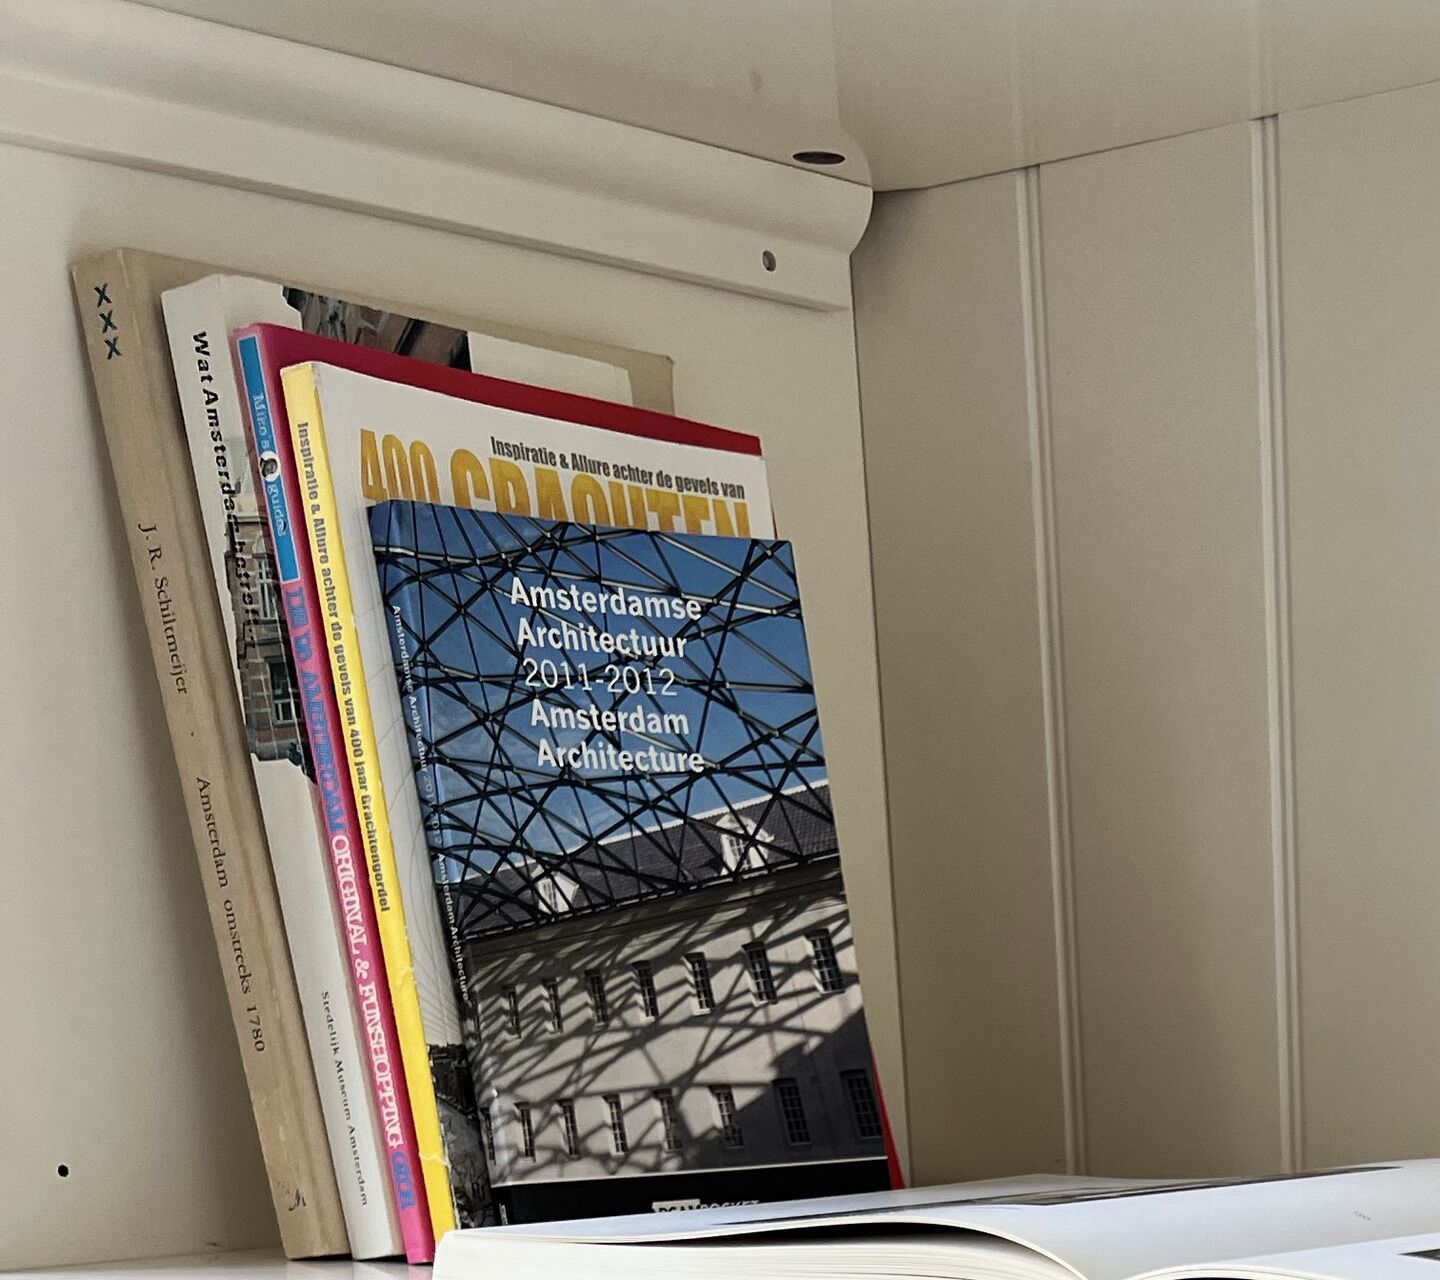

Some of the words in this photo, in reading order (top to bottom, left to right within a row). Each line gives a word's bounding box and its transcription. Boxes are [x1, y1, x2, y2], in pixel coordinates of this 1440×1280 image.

[192, 330, 214, 383] Wat
[202, 388, 240, 533] Amsterdam
[297, 422, 319, 501] Inspiratie
[490, 436, 557, 467] Inspiratie
[559, 454, 570, 470] &
[571, 452, 611, 478] Allure
[612, 461, 654, 487] achter
[655, 469, 673, 489] de
[675, 475, 720, 495] gevels
[721, 481, 746, 500] van
[137, 522, 157, 541] J.
[313, 518, 329, 564] Allure
[148, 548, 164, 571] R.
[321, 567, 338, 618] achter
[510, 576, 702, 621] Amsterdamse
[154, 575, 188, 697] Schiltmeijer
[330, 621, 343, 642] de
[517, 616, 688, 658] Architectuur
[333, 644, 351, 695] gevels
[522, 657, 678, 696] 2011-2012
[344, 698, 356, 726] van
[530, 698, 690, 735] Amsterdam
[350, 729, 364, 759] 400
[537, 737, 705, 773] Architecture
[197, 776, 229, 889] Amsterdam
[224, 899, 251, 995] omstreeks
[246, 1004, 266, 1053] 1780
[331, 834, 368, 955] ORIGINAL
[354, 958, 369, 980] &
[359, 982, 404, 1149] FUNSHOPPING
[321, 991, 339, 1056] Stedelijk
[335, 1059, 351, 1121] Museum
[348, 1125, 367, 1206] Amsterdam
